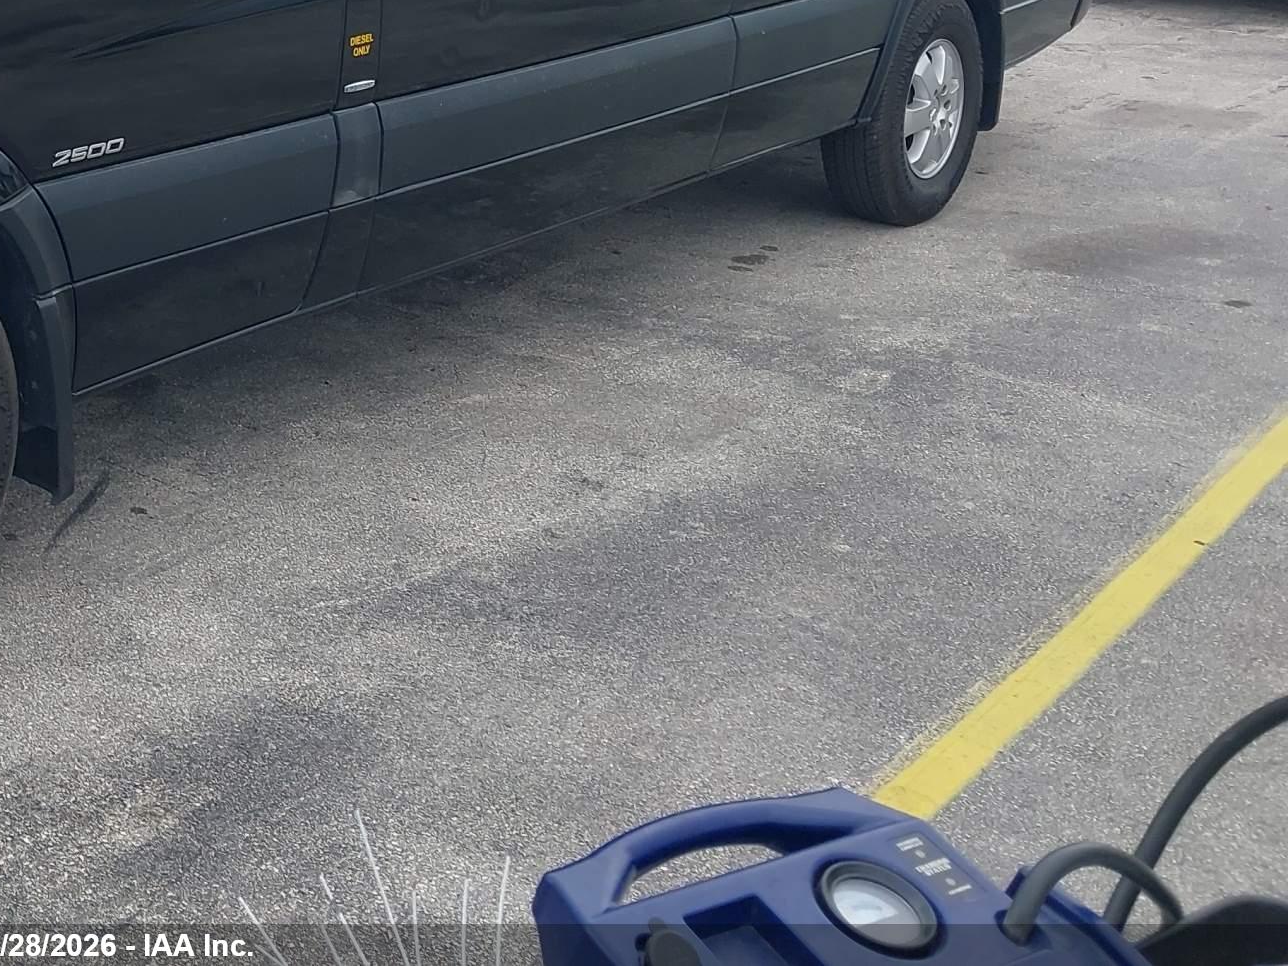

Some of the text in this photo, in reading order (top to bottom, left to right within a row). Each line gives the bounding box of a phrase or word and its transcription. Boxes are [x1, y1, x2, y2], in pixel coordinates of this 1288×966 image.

[350, 33, 374, 47] DIESEL
[353, 44, 371, 57] ONLY
[52, 137, 125, 168] 2500
